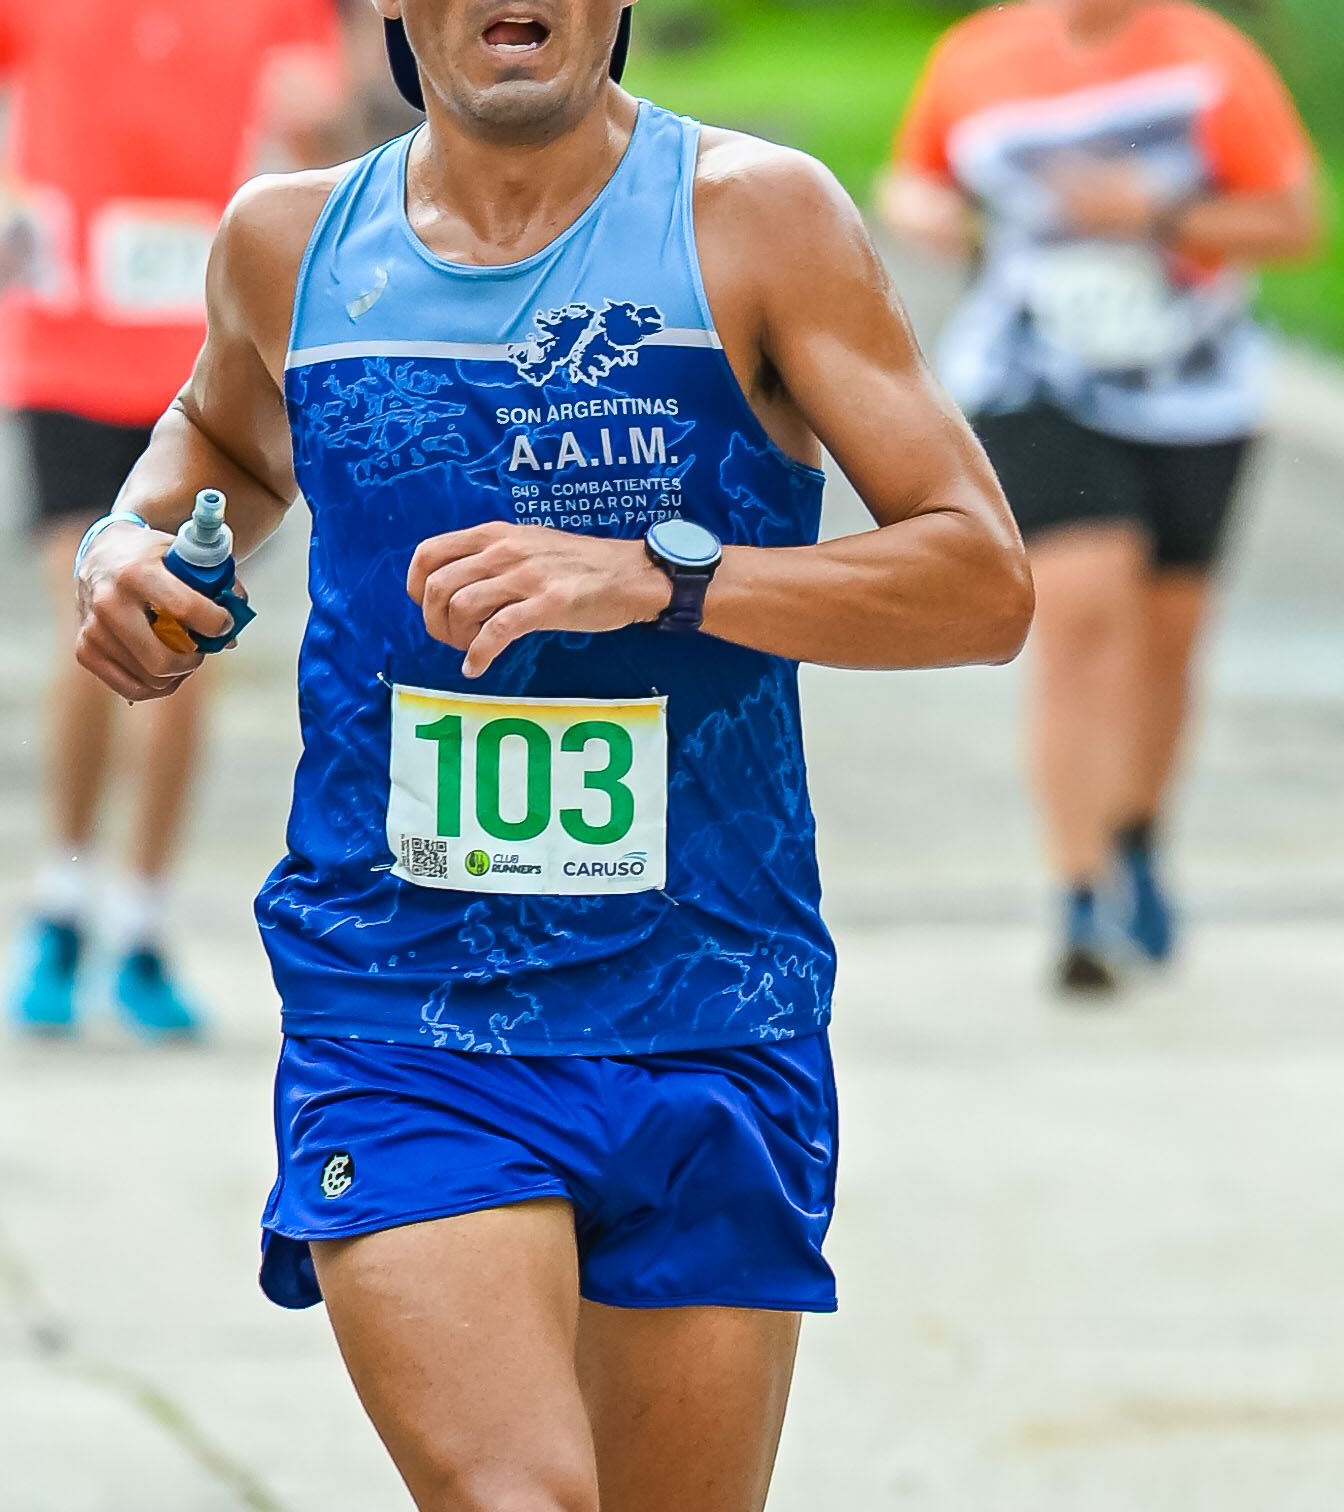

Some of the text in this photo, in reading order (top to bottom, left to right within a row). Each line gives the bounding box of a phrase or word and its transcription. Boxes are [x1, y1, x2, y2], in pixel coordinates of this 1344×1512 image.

[495, 397, 679, 425] SON ARGENTINAS
[508, 426, 679, 472] A.A.I.M.
[511, 477, 682, 498] 649 COMBATIENTES
[514, 493, 682, 514] OFRENDARON SU
[560, 514, 593, 528] POR
[597, 512, 621, 525] LA
[625, 509, 683, 523] PATRIA
[414, 714, 635, 845] 103
[492, 853, 520, 864] CLUB
[563, 861, 645, 877] CARUSO
